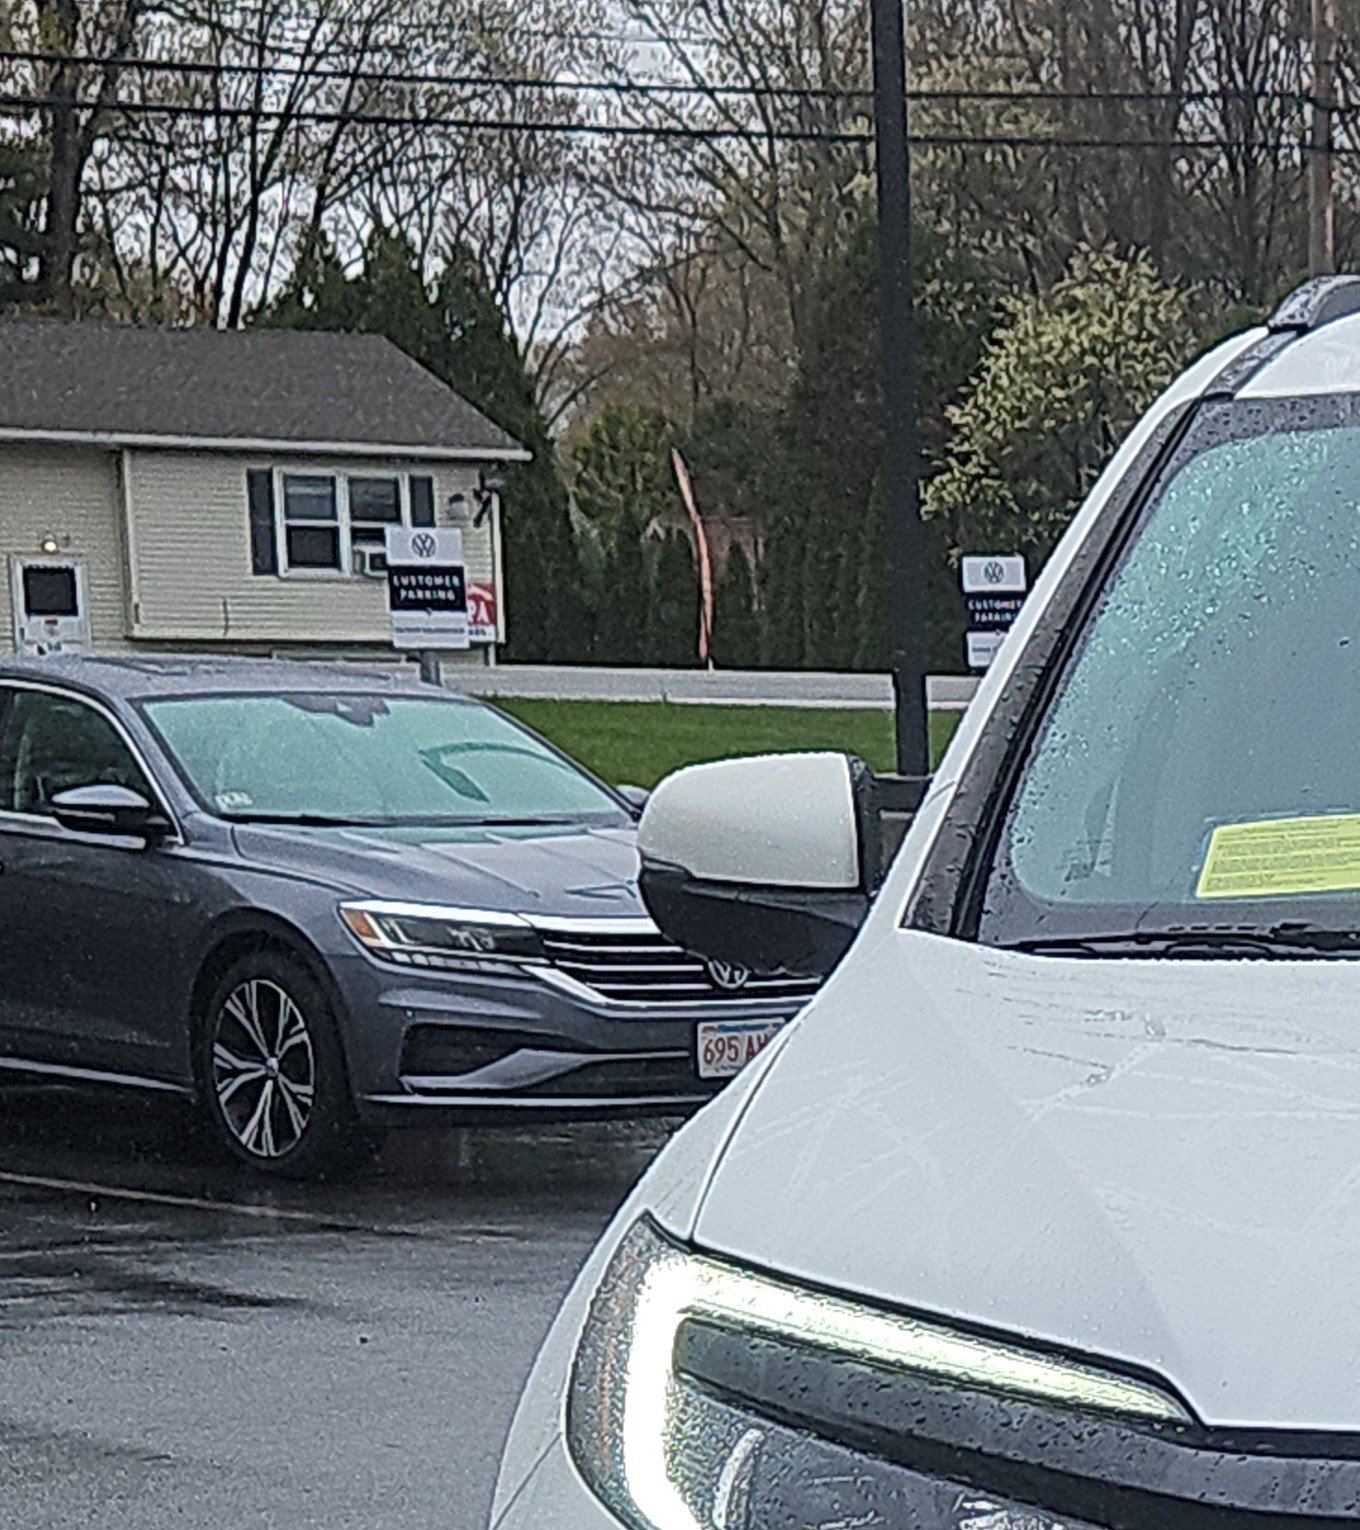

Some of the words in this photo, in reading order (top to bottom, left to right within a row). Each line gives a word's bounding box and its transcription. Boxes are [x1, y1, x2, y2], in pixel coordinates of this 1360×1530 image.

[393, 575, 460, 587] CUSTOMER
[400, 589, 455, 600] PARKING
[704, 1036, 739, 1065] 695
